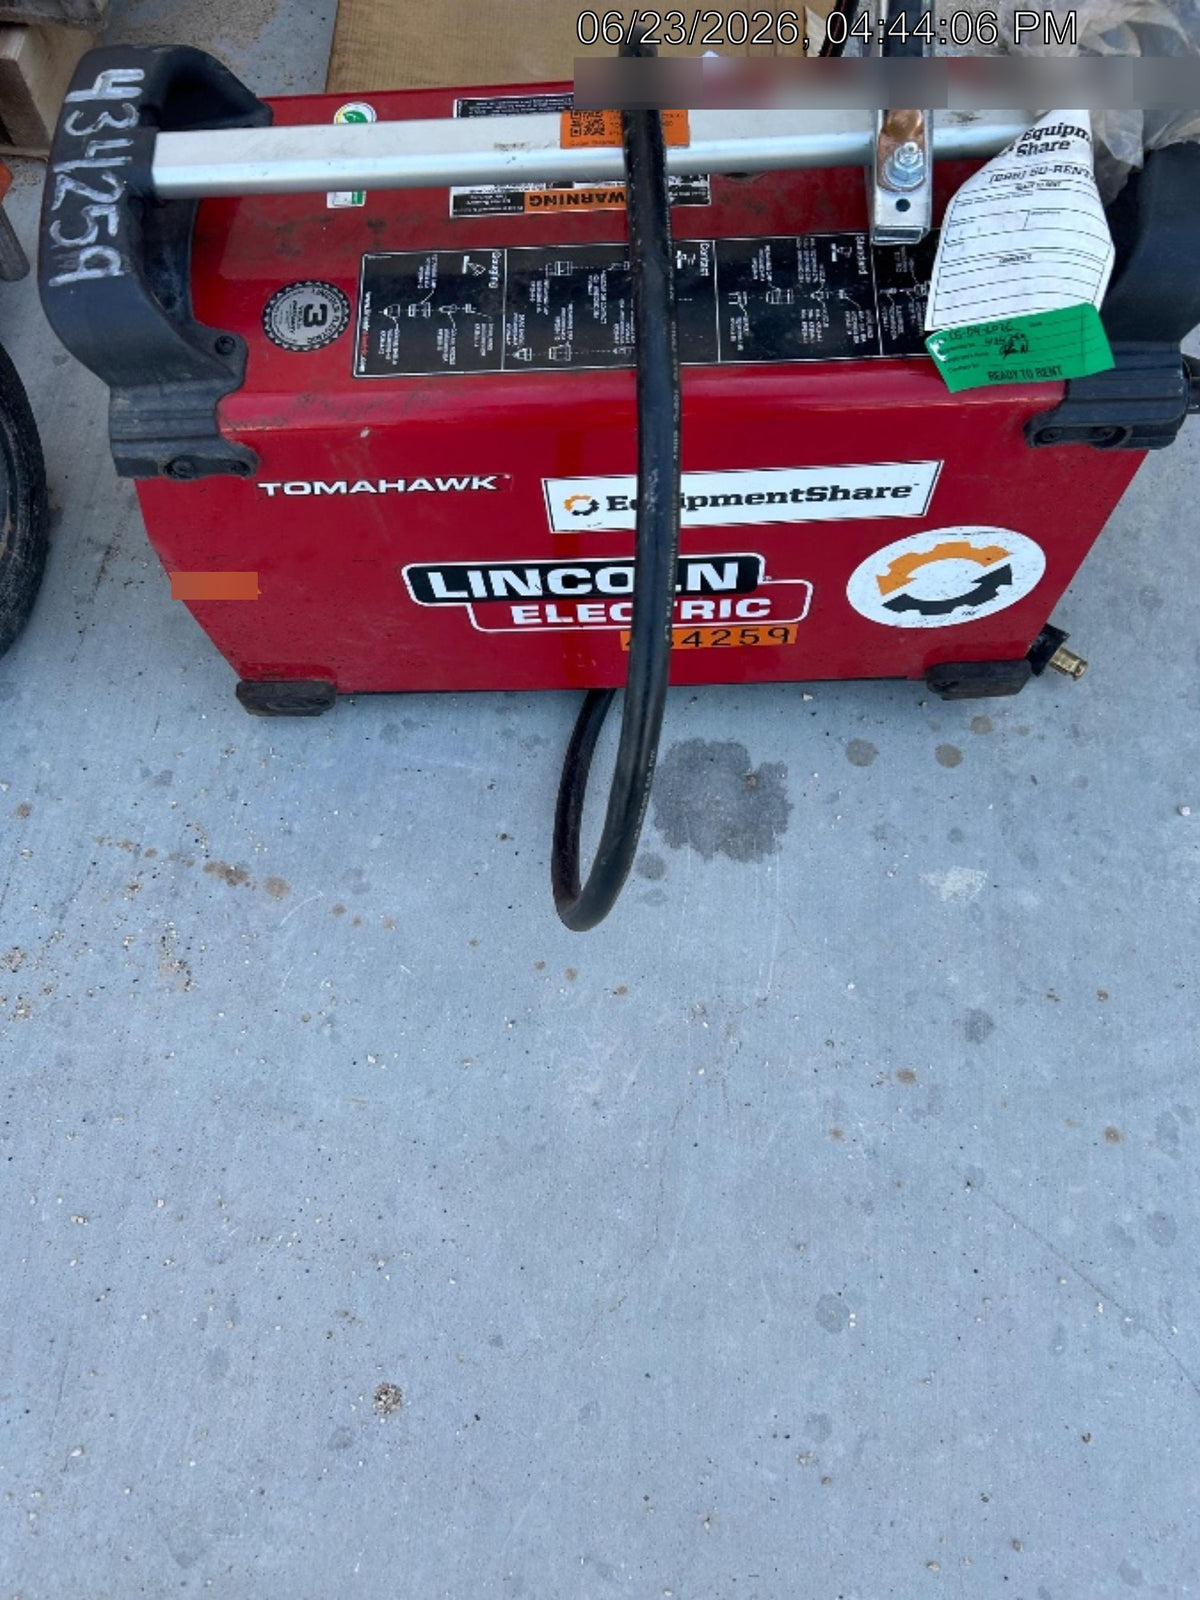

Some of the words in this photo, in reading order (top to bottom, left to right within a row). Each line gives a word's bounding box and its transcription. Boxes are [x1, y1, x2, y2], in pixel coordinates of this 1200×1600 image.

[1016, 140, 1071, 157] Share
[48, 68, 146, 287] 434259
[527, 191, 625, 208] WARNING
[855, 236, 869, 275] Standard
[303, 303, 327, 328] 3
[988, 368, 1019, 381] READY
[1020, 367, 1034, 380] TO
[1035, 365, 1062, 379] RENT
[258, 475, 499, 497] TOMAHAWK
[606, 484, 912, 512] EipmentShare
[427, 562, 738, 599] LINCON
[511, 598, 771, 626] ELECRIC
[625, 627, 791, 648] 4259
